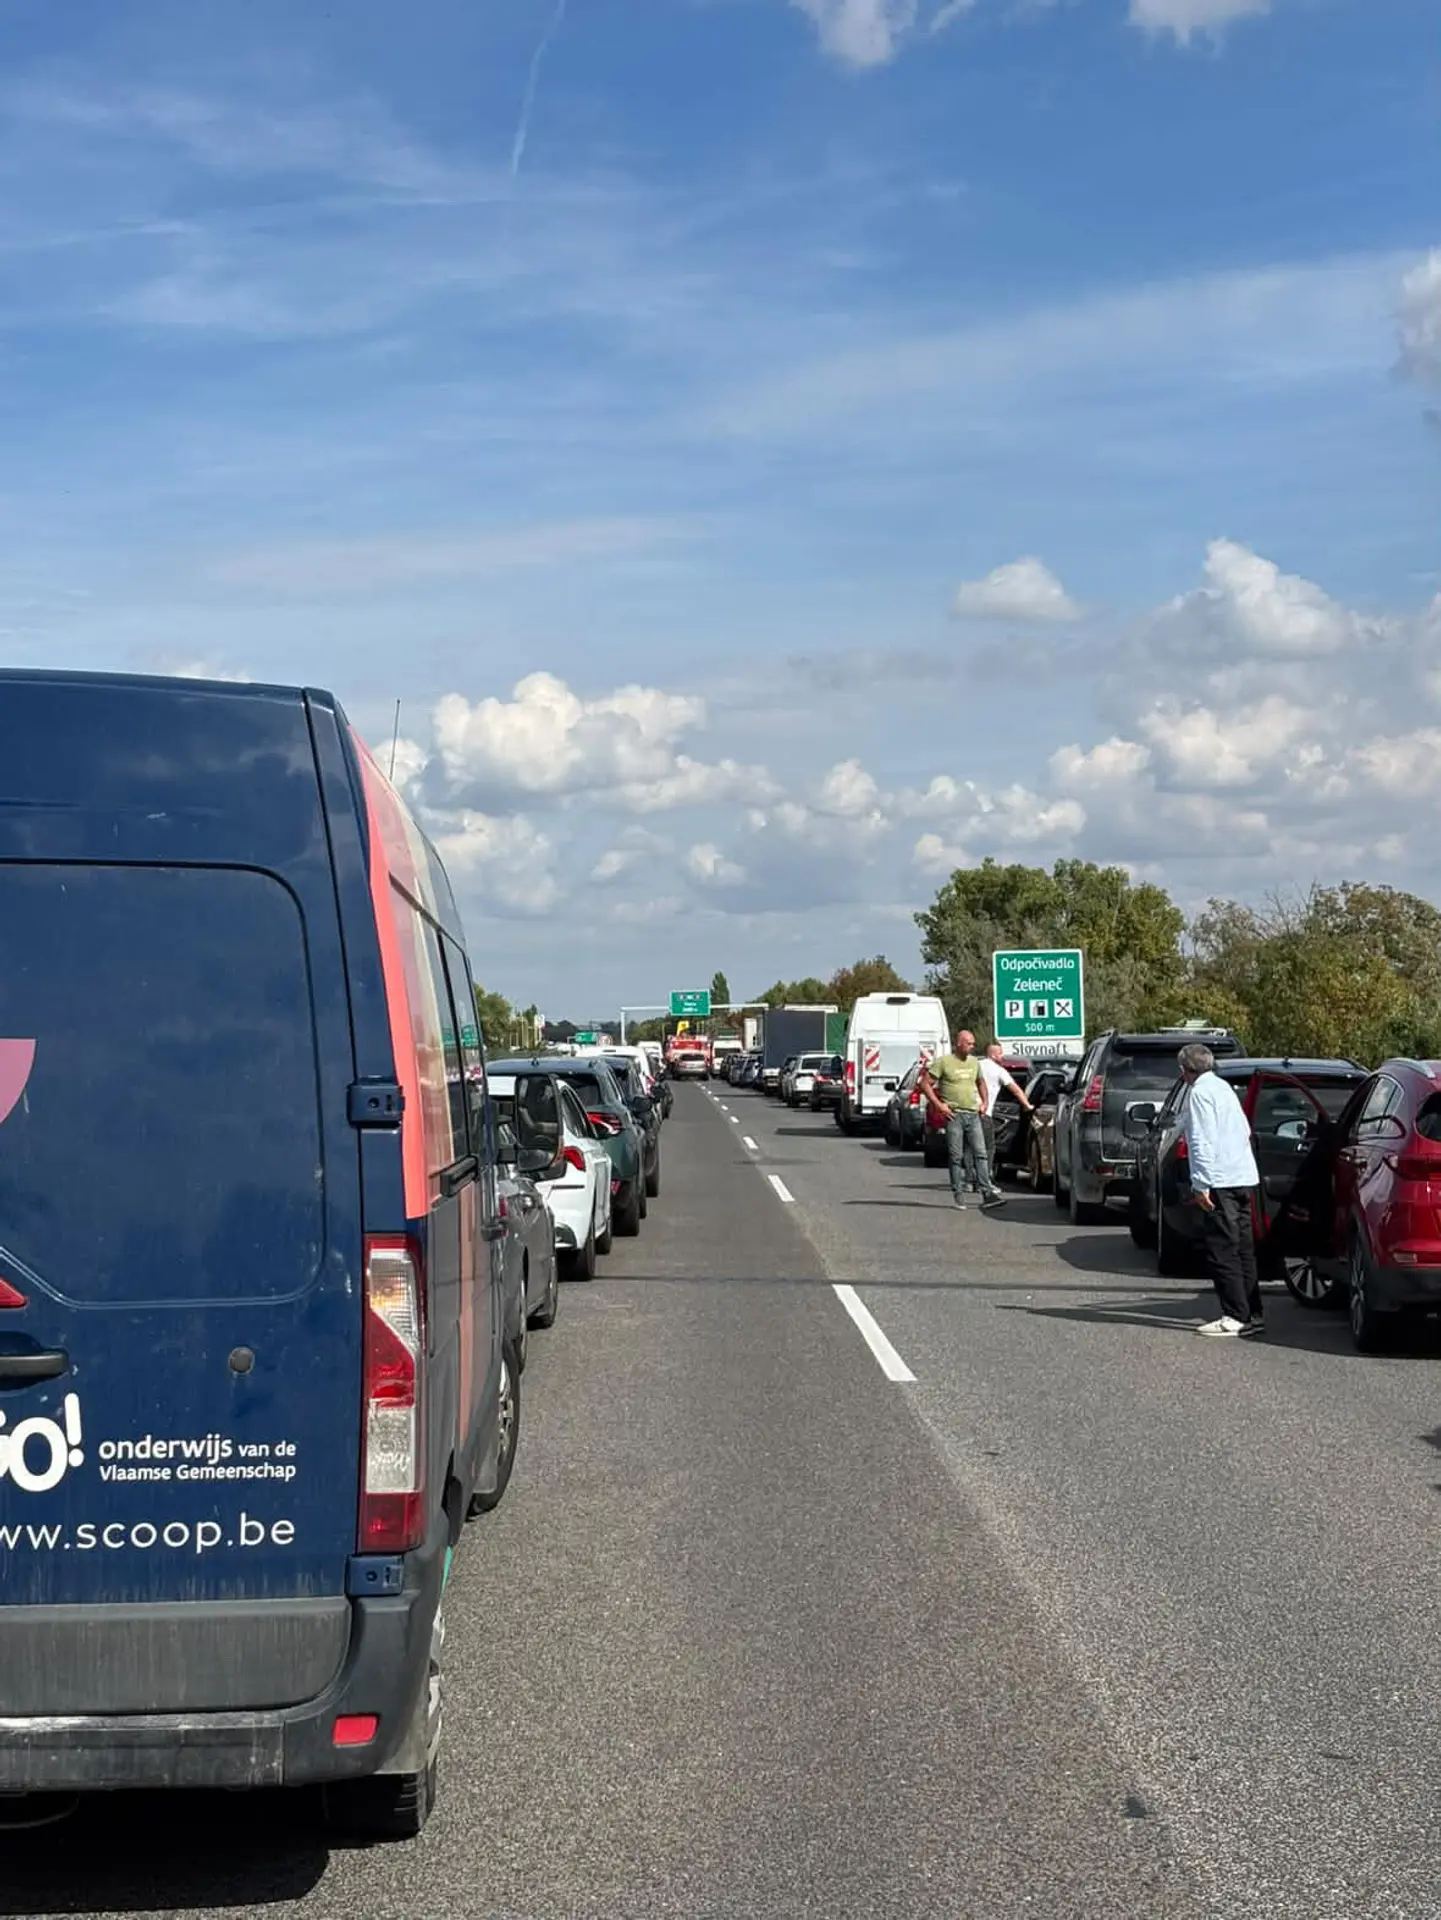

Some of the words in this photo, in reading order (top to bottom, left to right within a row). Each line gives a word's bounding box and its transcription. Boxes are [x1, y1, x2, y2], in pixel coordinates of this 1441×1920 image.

[1001, 957, 1075, 972] Odpočívadlo
[1013, 977, 1063, 992] Zeleneč
[1009, 1001, 1020, 1017] P
[1025, 1022, 1043, 1033] 500
[1046, 1023, 1055, 1032] m
[1012, 1042, 1068, 1056] Slovnaft
[0, 1393, 84, 1492] O!
[99, 1434, 232, 1464] onderwijs
[238, 1443, 270, 1457] van
[275, 1441, 297, 1456] de
[100, 1465, 171, 1481] Vlaamse
[176, 1462, 296, 1482] Gemeenschap
